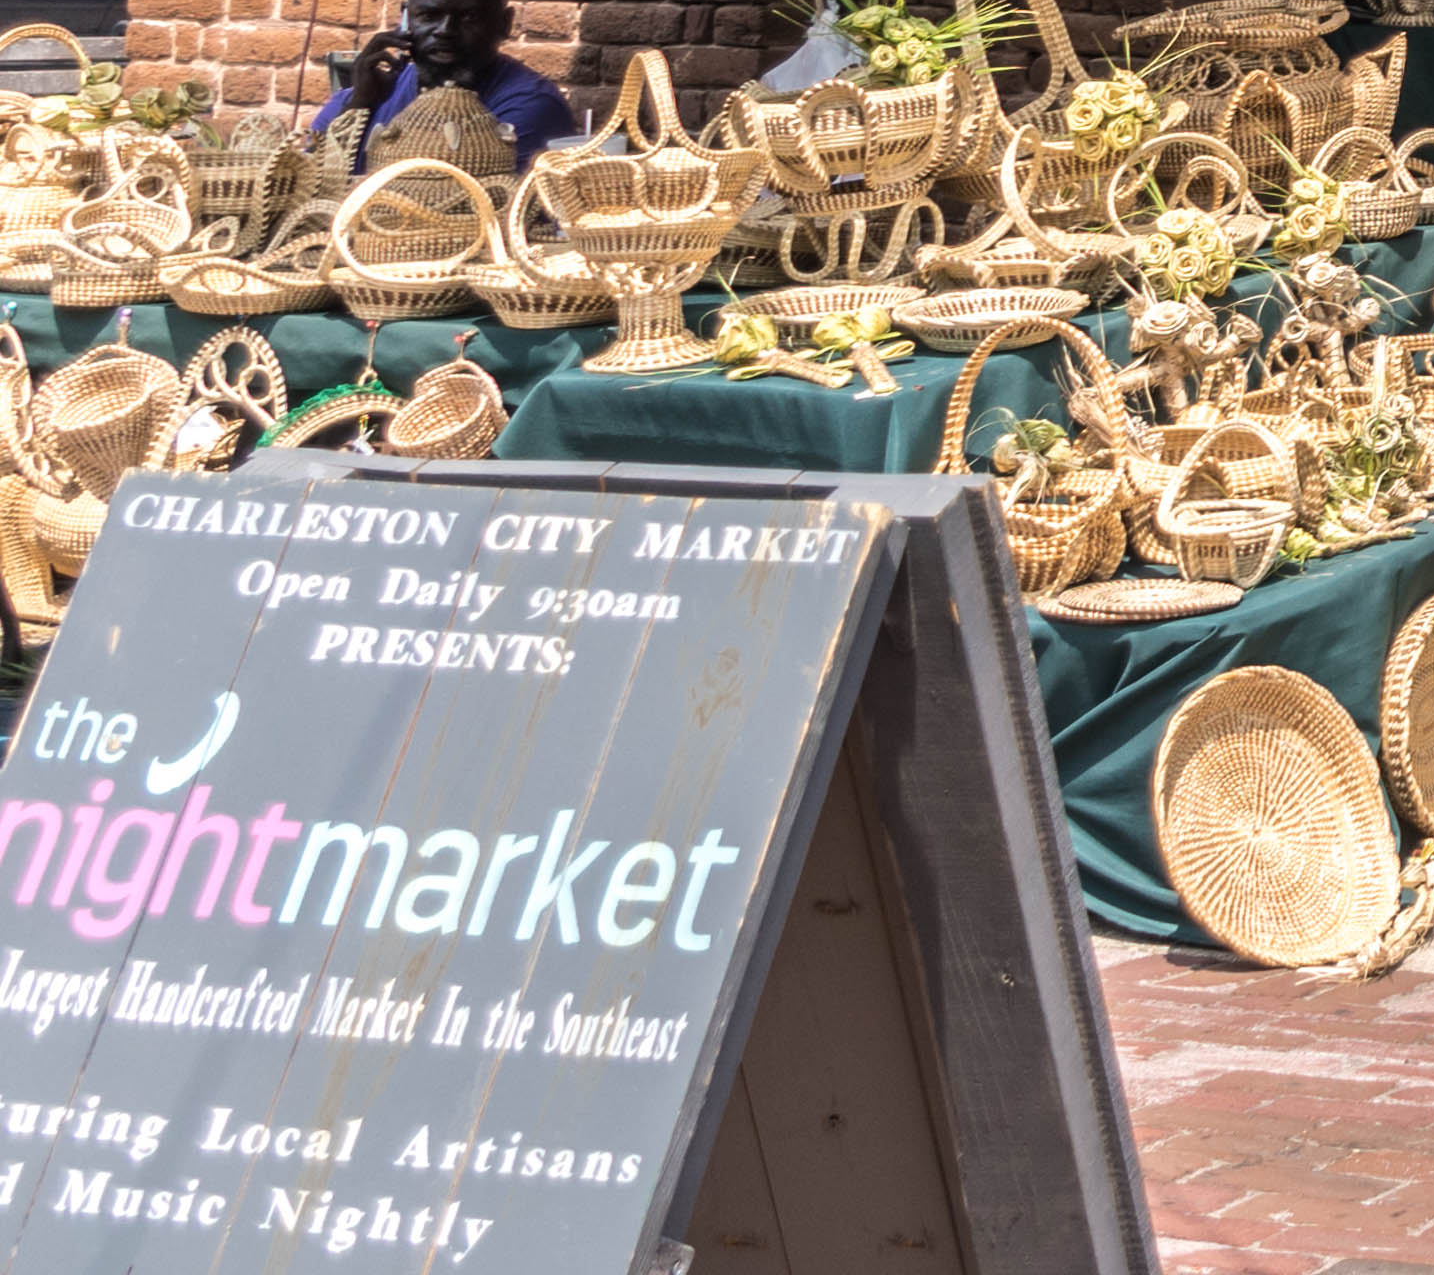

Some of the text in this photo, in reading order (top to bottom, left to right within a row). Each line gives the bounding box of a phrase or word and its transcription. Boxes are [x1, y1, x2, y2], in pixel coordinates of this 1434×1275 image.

[123, 493, 860, 564] CHARLESTON CITY MARKET
[237, 559, 681, 624] Open Daily 9:30am
[309, 623, 576, 675] PRESENTS:
[34, 697, 138, 763] the
[0, 778, 740, 951] nightmarket
[0, 949, 689, 1063] Largest Handcrafted Market In the Southeast
[0, 1094, 643, 1183] uring Local Artisans
[53, 1167, 227, 1226] Music
[257, 1186, 495, 1263] Nightly
